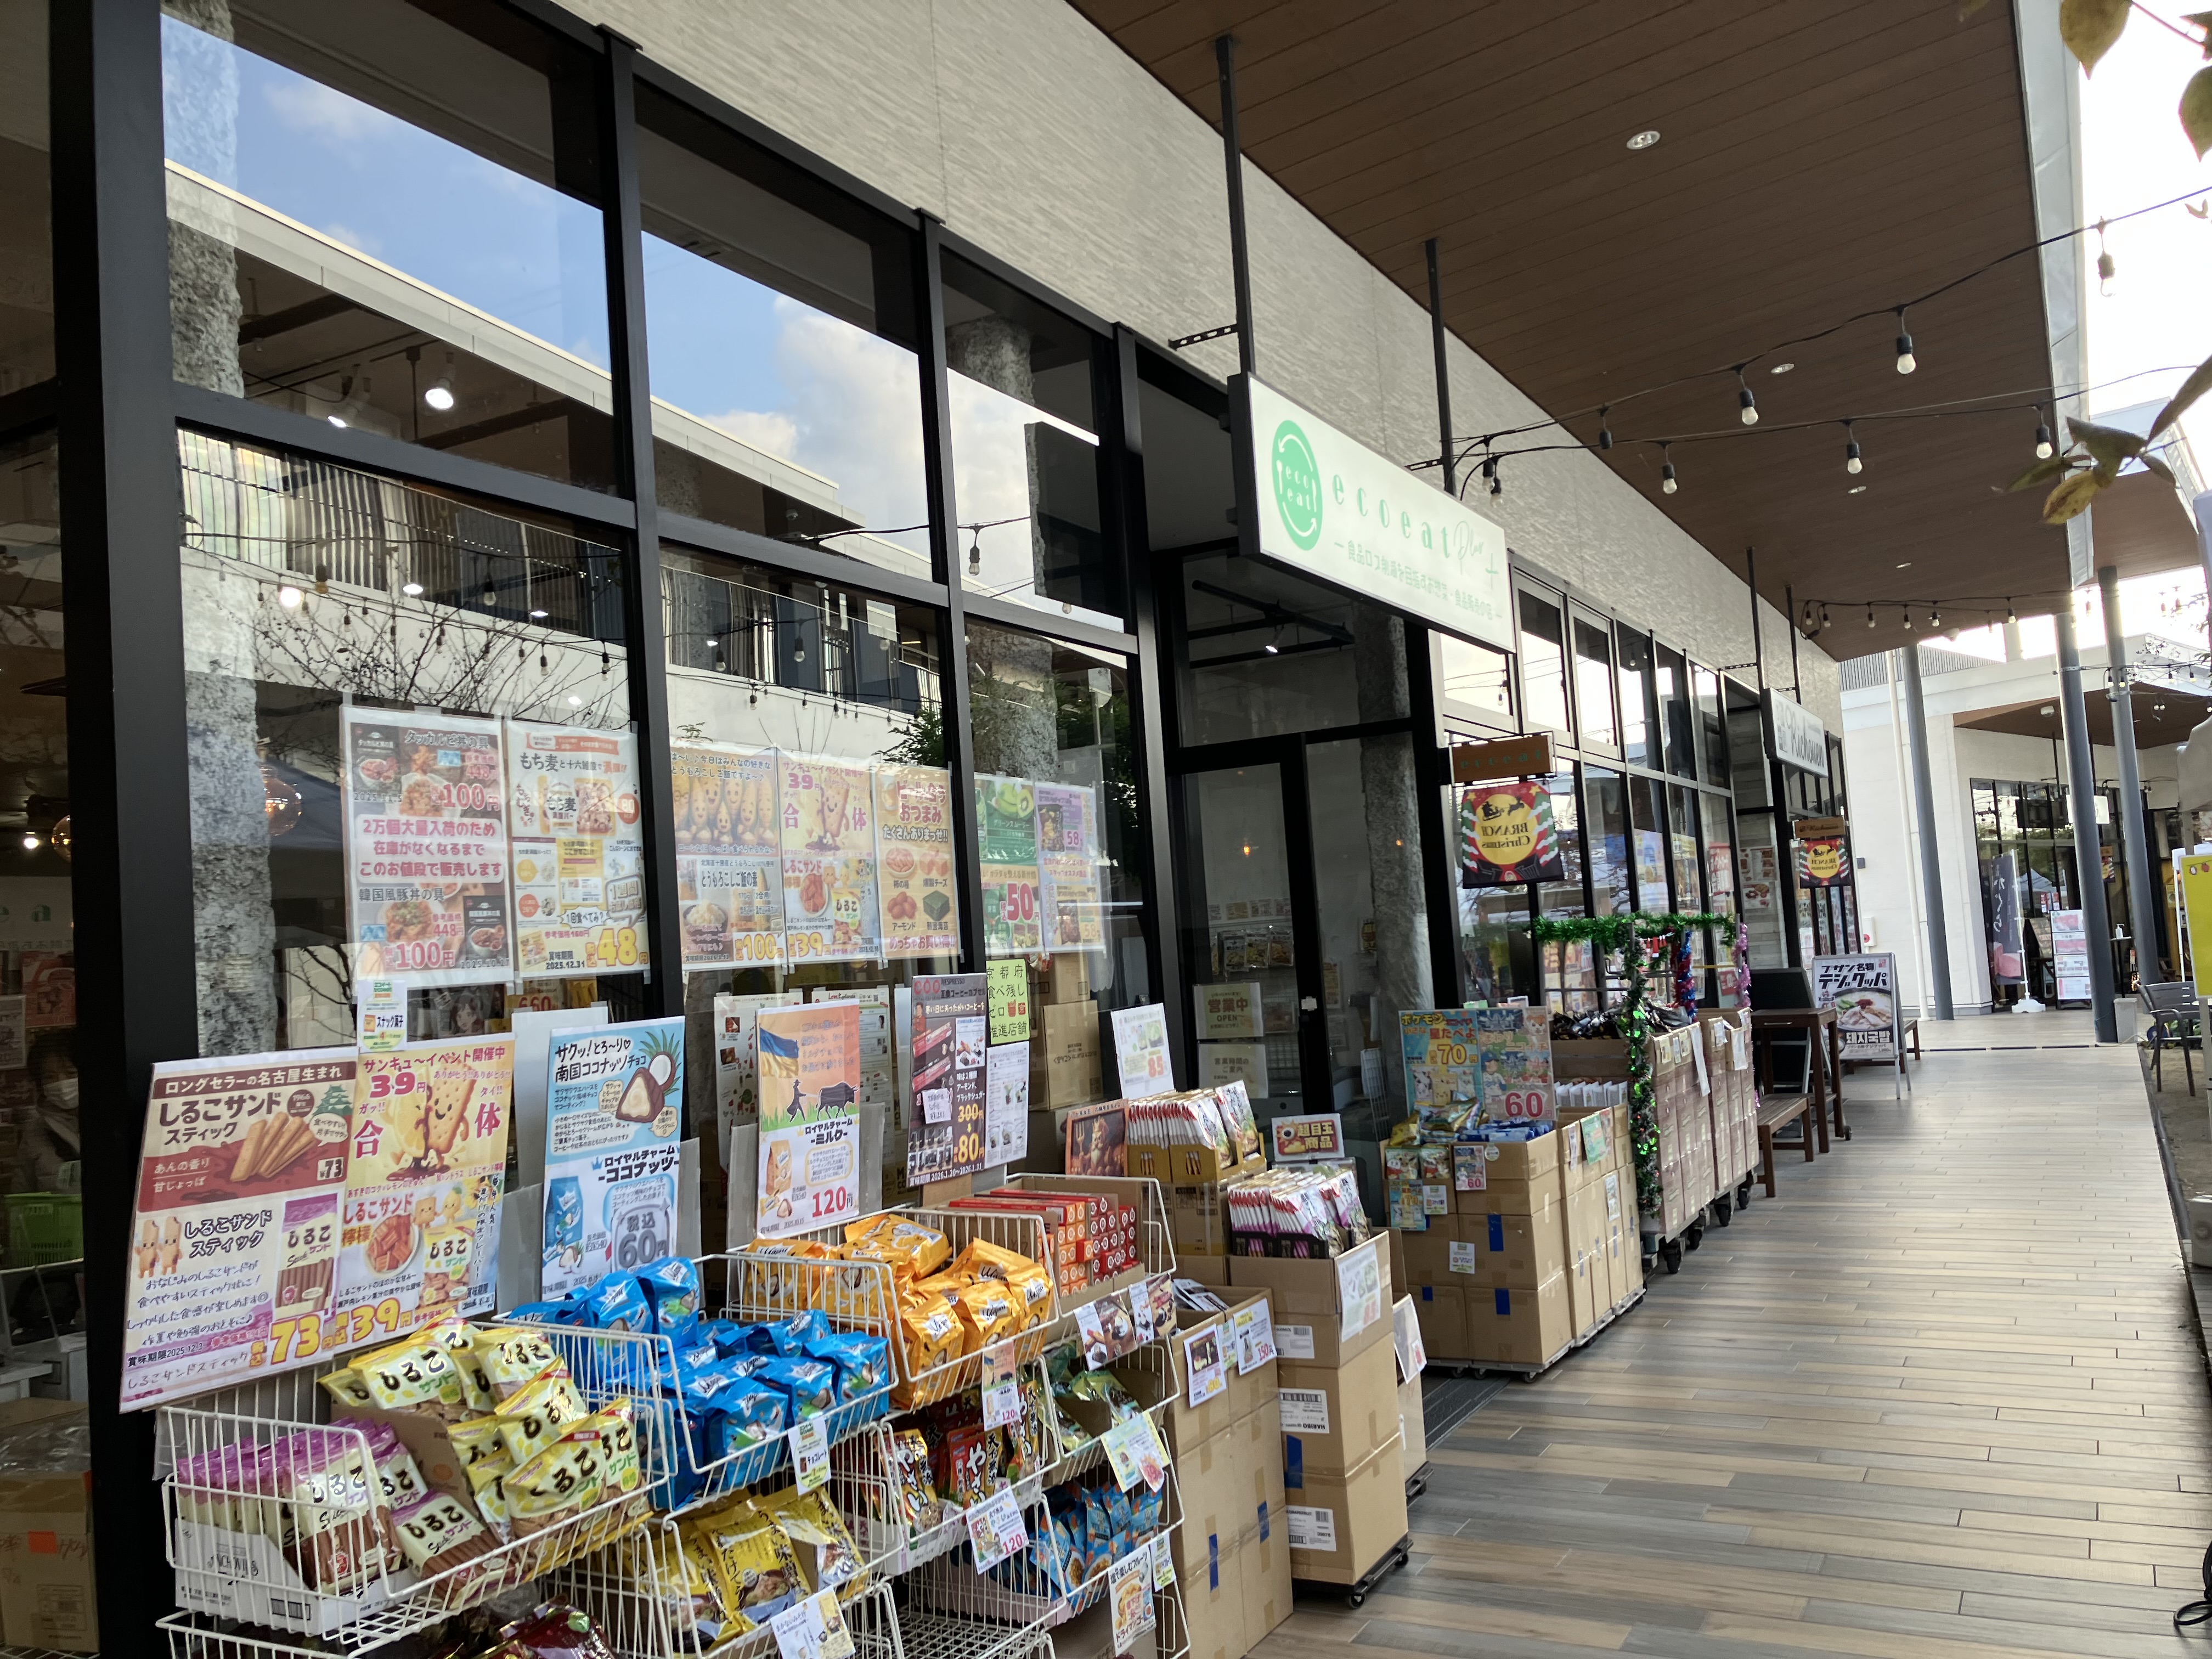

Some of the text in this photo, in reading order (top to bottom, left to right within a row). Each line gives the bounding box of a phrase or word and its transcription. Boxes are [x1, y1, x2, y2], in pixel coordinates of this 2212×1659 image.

[1285, 464, 1308, 488] eco
[1286, 487, 1312, 511] eat
[783, 803, 867, 832] 合 体
[899, 805, 943, 825] おつまみ
[363, 819, 495, 837] 2万個大量入荷のため
[883, 825, 949, 843] たくさんありまっせ!!
[374, 840, 485, 856] 在庫がなくなるまで
[360, 861, 501, 877] このお値段で販売します
[783, 859, 822, 873] しるこサンド
[893, 879, 910, 889] 柿の種
[359, 888, 444, 902] 韓国風豚丼の具
[836, 899, 857, 912] しるこ
[891, 922, 916, 931] アーモンド
[988, 983, 1025, 1000] 食べ残し
[925, 1001, 985, 1014] 寒い日にあったかいコーヒーを
[989, 1006, 1005, 1019] ゼロ
[1207, 997, 1249, 1014] 営業中
[1401, 1013, 1446, 1026] ポケモン
[990, 1021, 1028, 1038] 推進店舗
[1429, 1028, 1476, 1040] 星たべよ
[1846, 1030, 1891, 1044] 돼지국밥
[1214, 1057, 1249, 1065] 営業時間の
[165, 1065, 342, 1094] ロングセラーの名古屋生まれ
[159, 1092, 282, 1127] しるこサンド
[1505, 1091, 1544, 1118] 60
[164, 1121, 238, 1146] スティック
[353, 1101, 501, 1159] 合 体
[805, 1118, 853, 1135] ロイヤルチャーム
[1297, 1121, 1334, 1137] 超目玉
[1305, 1136, 1334, 1149] 商品
[604, 1145, 675, 1167] ロイヤルチャーム
[153, 1157, 211, 1175] あんの香り
[153, 1176, 207, 1194] 甘じょっぱ
[343, 1193, 414, 1224] しるこサンド
[184, 1209, 273, 1239] しるこサンド
[188, 1229, 264, 1259] スティック
[286, 1224, 331, 1249] しるこ
[430, 1238, 466, 1260] しるこ
[145, 1260, 261, 1291] おなじみのしるこサンドが
[127, 1351, 250, 1390] しるこサンドスティック
[380, 1348, 447, 1391] しるこ
[417, 1372, 456, 1393] サンド
[1002, 1409, 1015, 1421] 120
[608, 1452, 637, 1477] サンド
[806, 1449, 827, 1466] チョコレート
[402, 1505, 466, 1539] しるこ
[444, 1520, 473, 1537] サンド
[1002, 1533, 1023, 1555] 120
